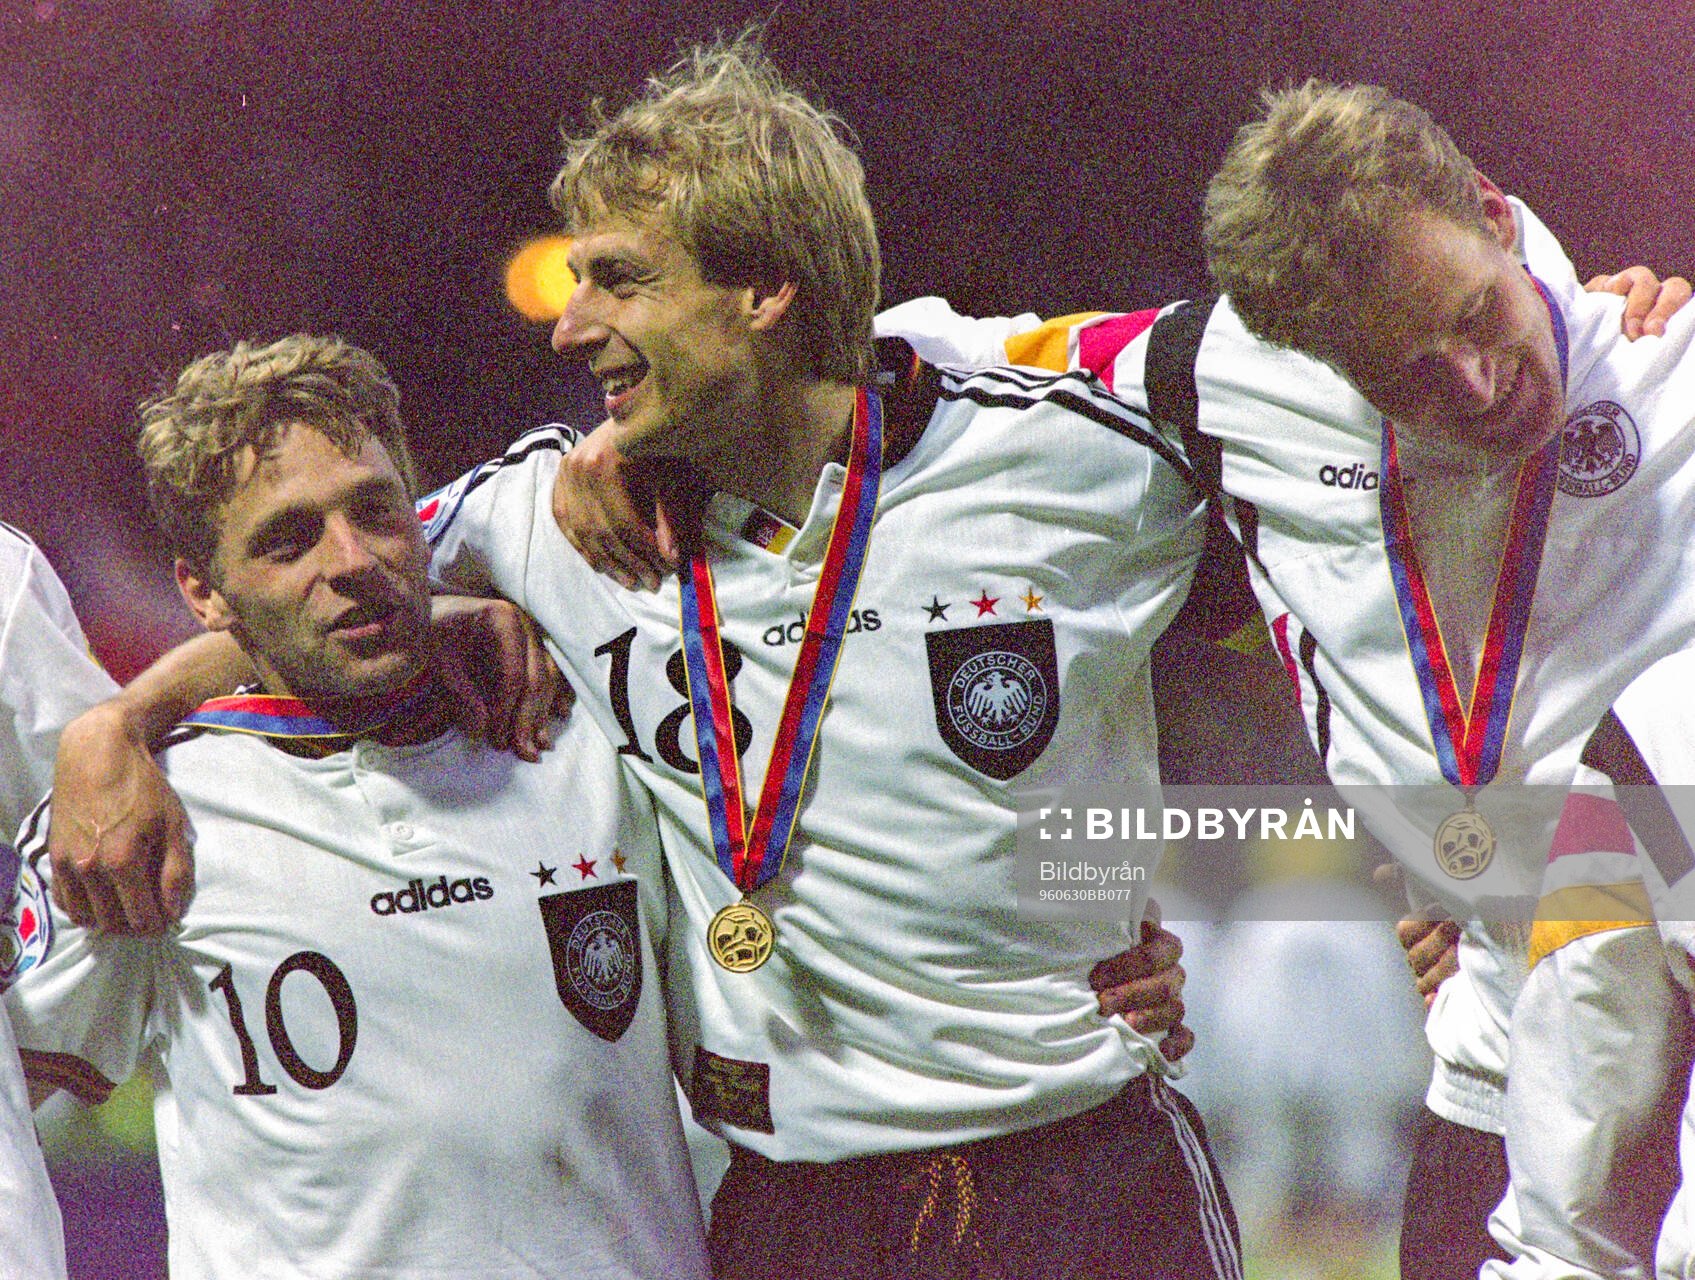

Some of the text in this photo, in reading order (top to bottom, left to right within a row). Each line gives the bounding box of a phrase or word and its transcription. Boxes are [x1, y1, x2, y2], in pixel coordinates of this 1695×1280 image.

[762, 608, 882, 646] adas
[954, 655, 1036, 690] DEUTSCHER
[594, 626, 753, 775] 18
[370, 875, 495, 916] adidas
[208, 950, 358, 1096] 10
